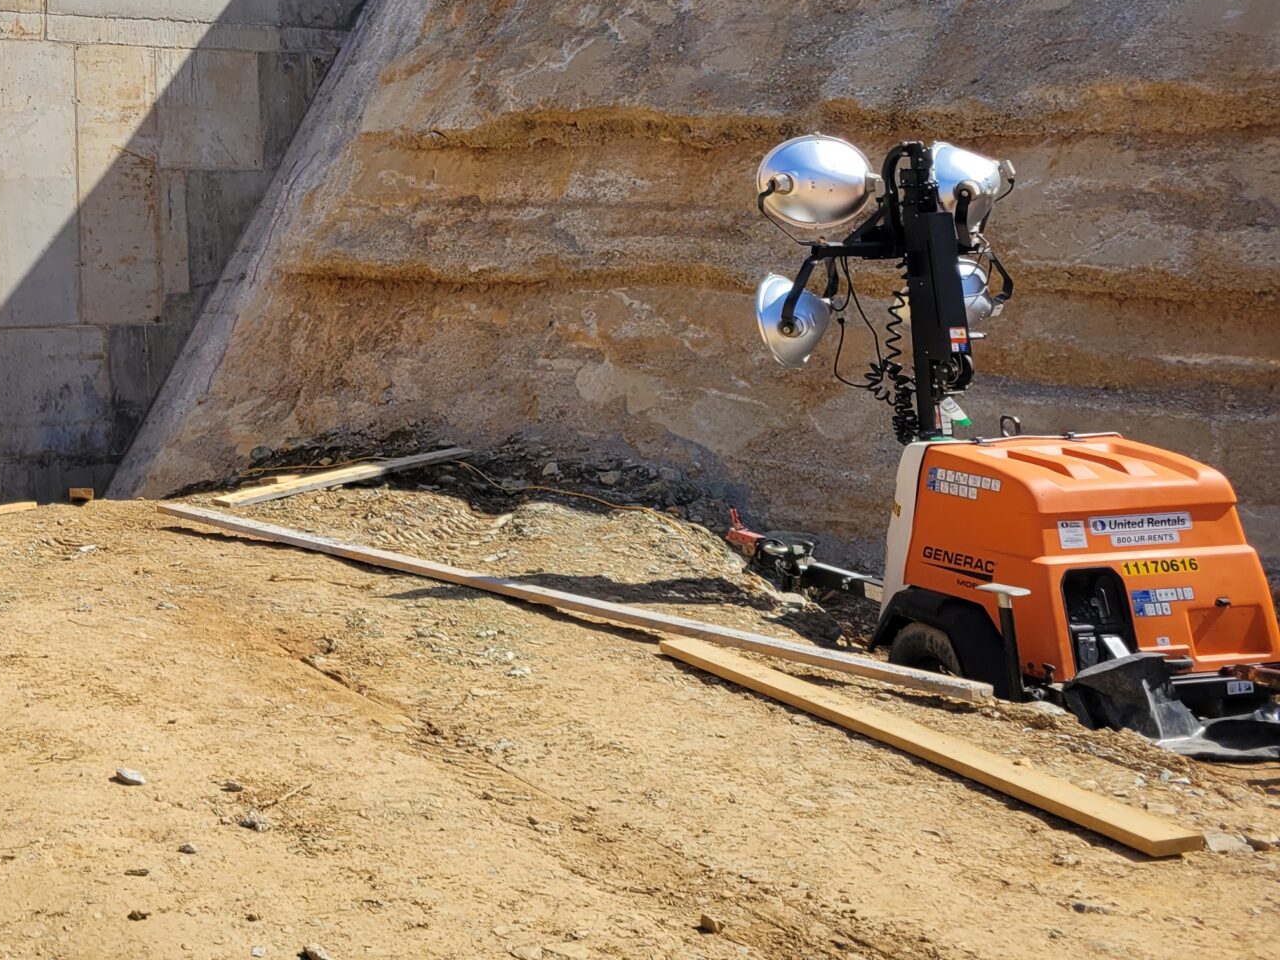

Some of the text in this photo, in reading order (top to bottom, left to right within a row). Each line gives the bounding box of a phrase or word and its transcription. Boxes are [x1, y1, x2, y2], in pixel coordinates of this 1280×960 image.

[1109, 516, 1186, 530] United Rentals
[1116, 533, 1174, 544] 800-UR-RENTS
[923, 546, 995, 573] GENERAC
[1123, 558, 1198, 575] 11170616
